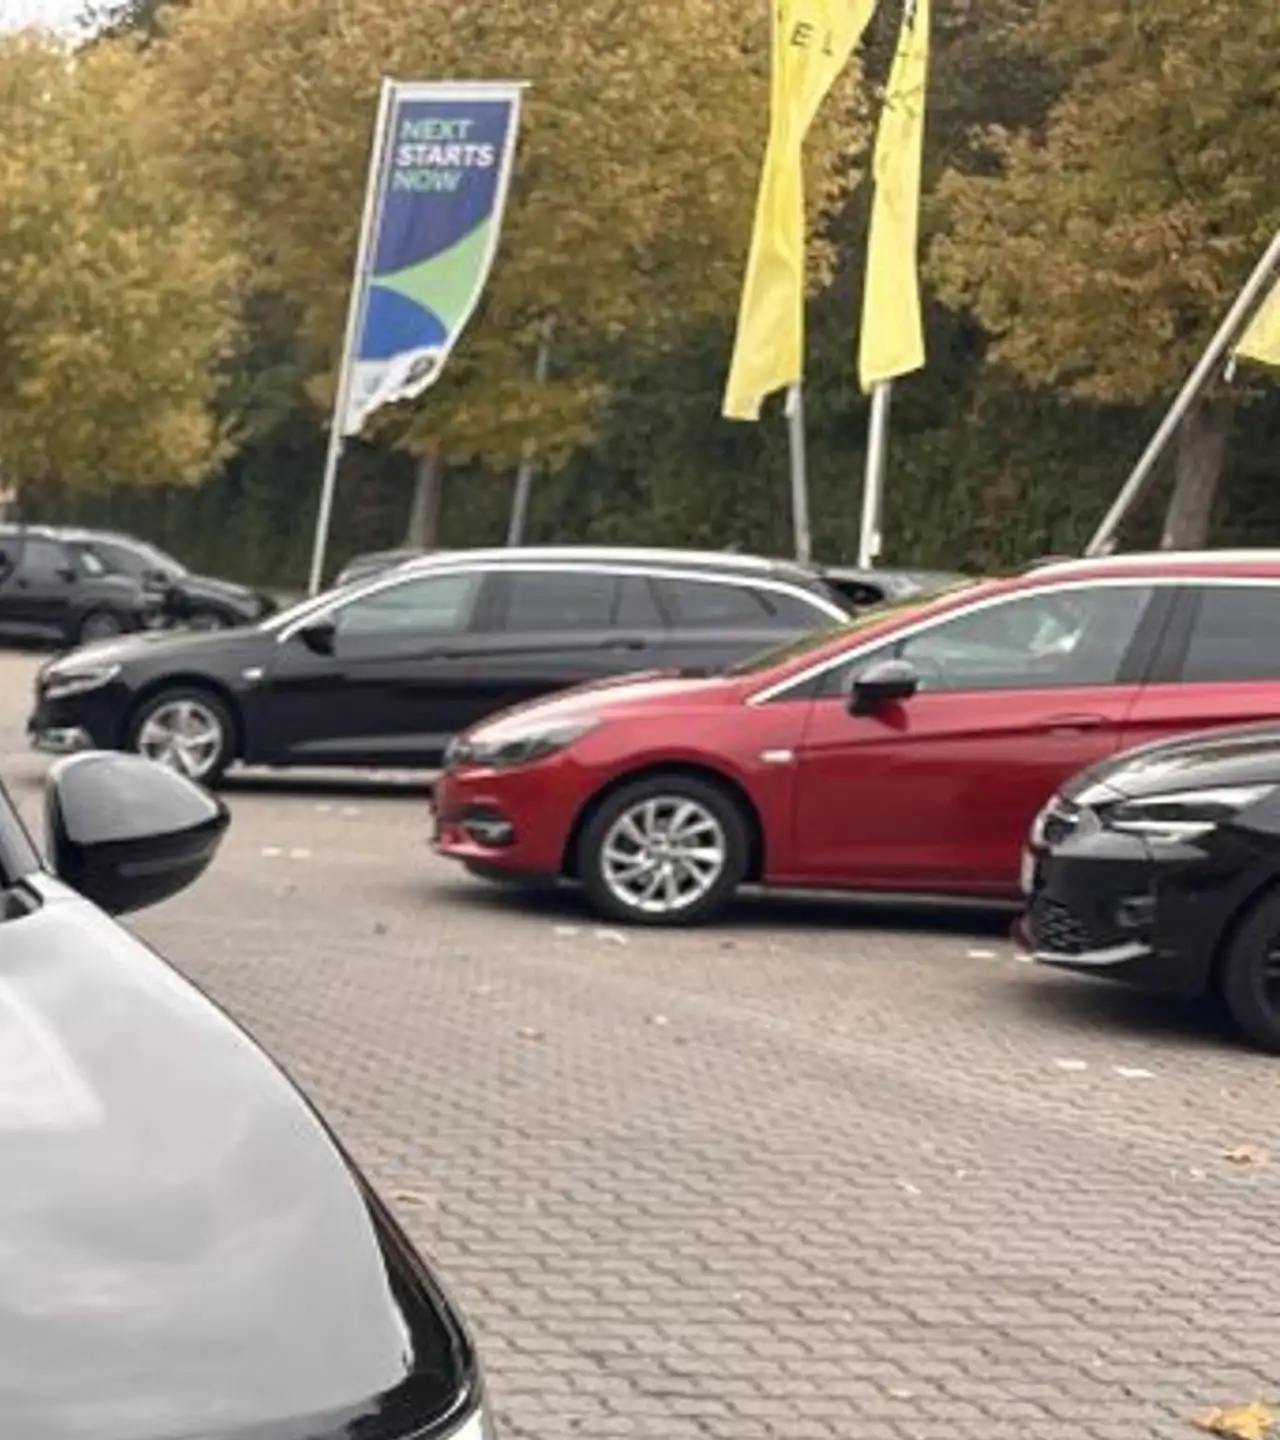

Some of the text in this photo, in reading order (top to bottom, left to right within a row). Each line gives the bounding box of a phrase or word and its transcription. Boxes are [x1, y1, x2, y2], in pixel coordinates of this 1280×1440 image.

[400, 118, 473, 140] NEXT
[397, 143, 495, 167] STARTS
[392, 170, 461, 192] NOW
